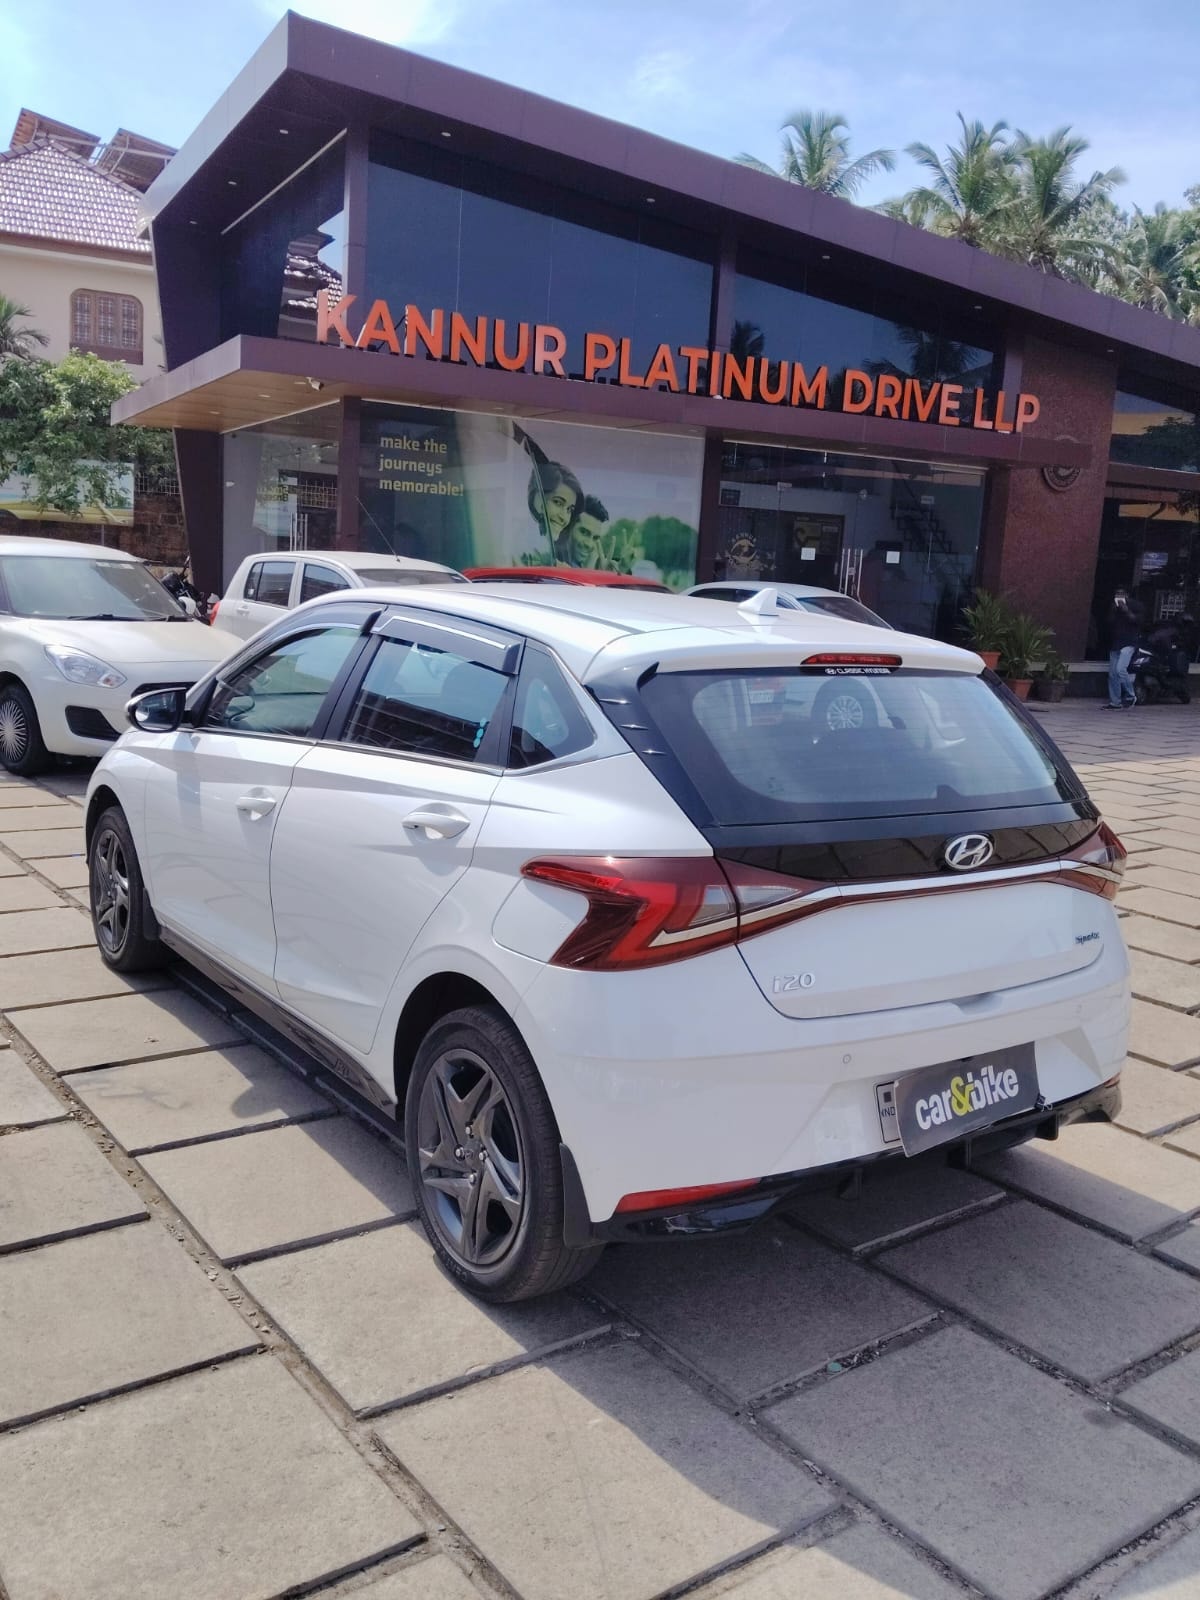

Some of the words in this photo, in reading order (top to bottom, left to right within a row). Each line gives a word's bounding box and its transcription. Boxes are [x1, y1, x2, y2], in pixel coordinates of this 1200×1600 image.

[316, 289, 567, 376] KANNUR
[584, 333, 829, 409] PLATINUM
[842, 368, 963, 426] DRIVE
[973, 388, 1040, 433] LLP
[380, 435, 420, 451] make
[423, 438, 447, 454] the
[379, 454, 442, 477] journeys
[379, 479, 464, 497] memorable!
[773, 972, 816, 993] i20
[915, 1065, 1019, 1130] car&bike
